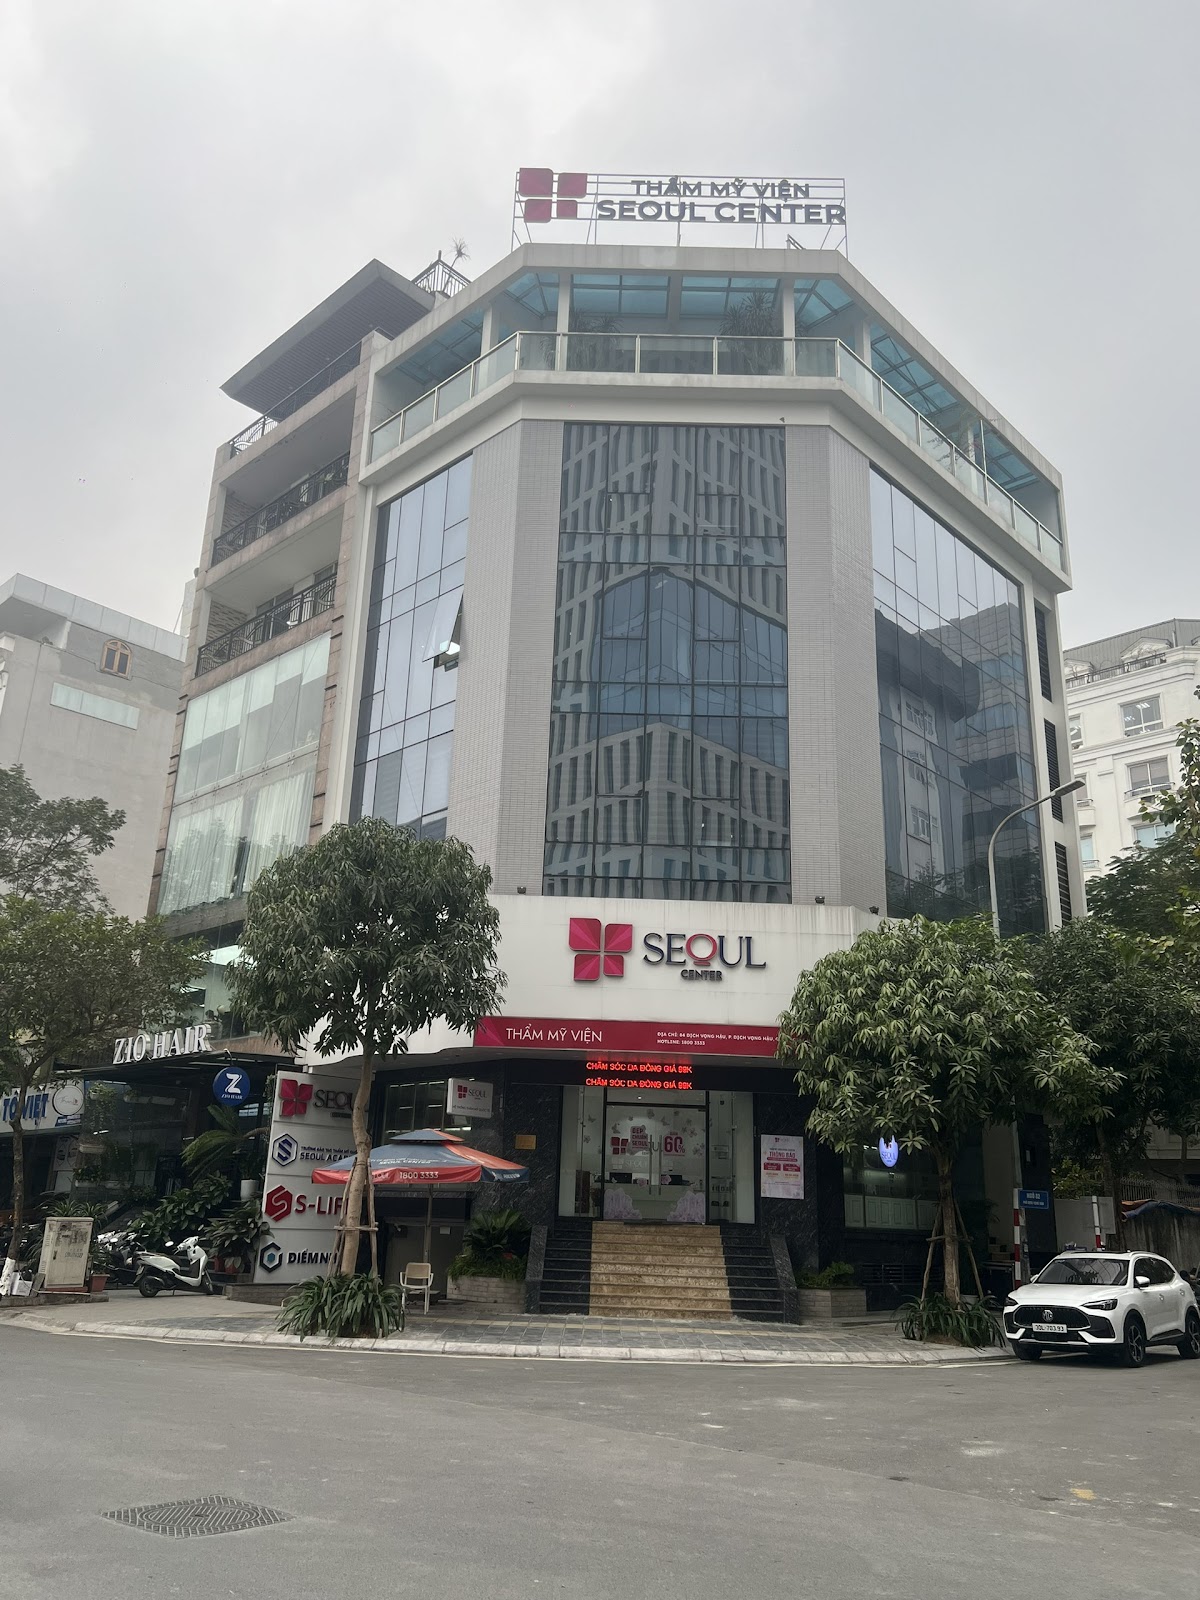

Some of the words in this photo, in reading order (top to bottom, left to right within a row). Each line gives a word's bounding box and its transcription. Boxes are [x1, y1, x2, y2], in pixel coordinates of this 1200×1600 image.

[752, 179, 809, 203] VIỆN
[597, 199, 706, 222] SEOUL
[714, 202, 846, 225] CENTER
[643, 932, 767, 969] SEOUL
[680, 969, 723, 982] CENTER
[506, 1023, 543, 1040] THẨM
[547, 1027, 567, 1041] MỸ
[570, 1027, 602, 1044] VIỆN
[113, 1033, 150, 1065] ZIO
[151, 1024, 211, 1060] HAIR
[609, 1062, 627, 1071] SÓC
[663, 1064, 677, 1074] GIÁ
[609, 1078, 626, 1087] SÓC
[627, 1080, 638, 1088] DA
[663, 1080, 677, 1089] GIÁ
[469, 1089, 487, 1098] SEOUL
[664, 1136, 686, 1153] 60%
[300, 1152, 325, 1161] SEOUL
[400, 1171, 418, 1179] 1800
[420, 1171, 439, 1179] 3333
